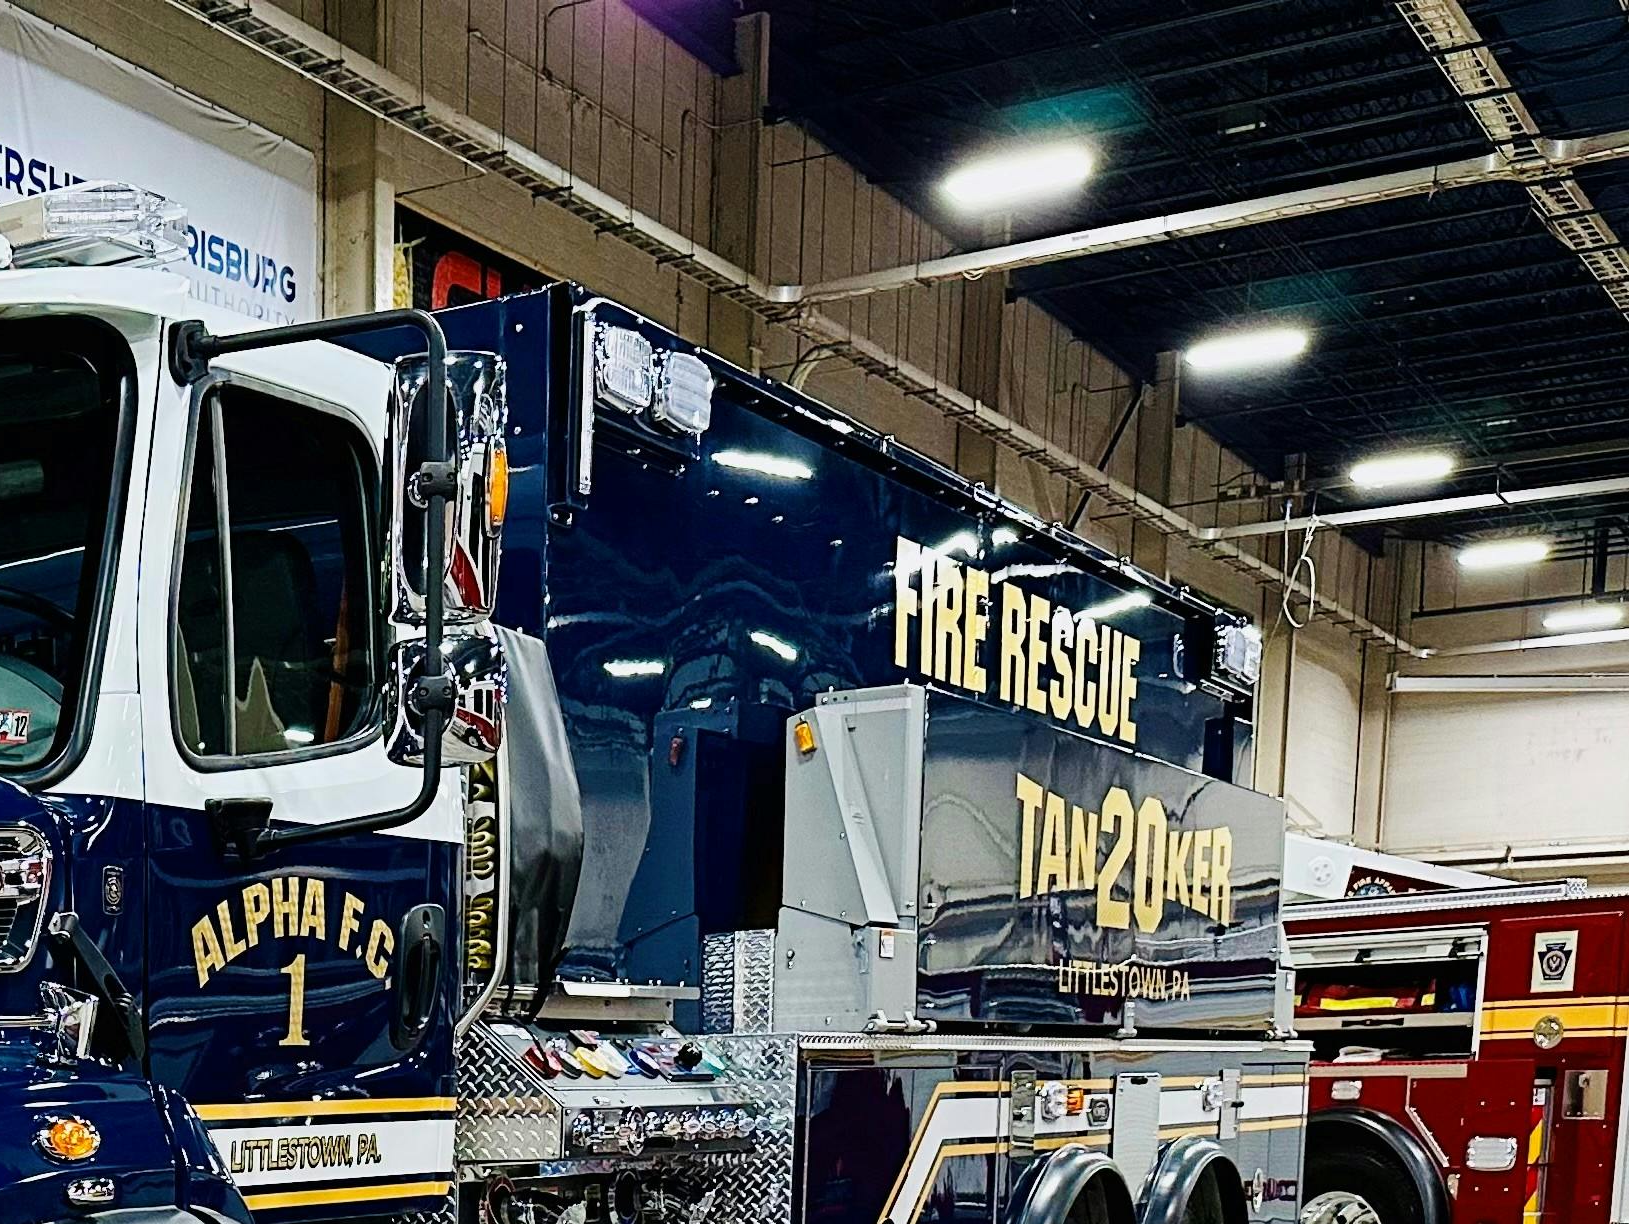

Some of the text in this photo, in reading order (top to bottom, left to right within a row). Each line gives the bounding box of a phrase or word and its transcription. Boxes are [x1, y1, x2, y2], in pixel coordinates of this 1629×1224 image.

[187, 224, 296, 303] RISBURG
[894, 535, 1141, 744] FIRE RESCUE
[14, 715, 28, 737] 12
[191, 876, 326, 989] ALPHA
[278, 953, 311, 1046] 1
[230, 1132, 382, 1174] LITTLESTOWN, PA.
